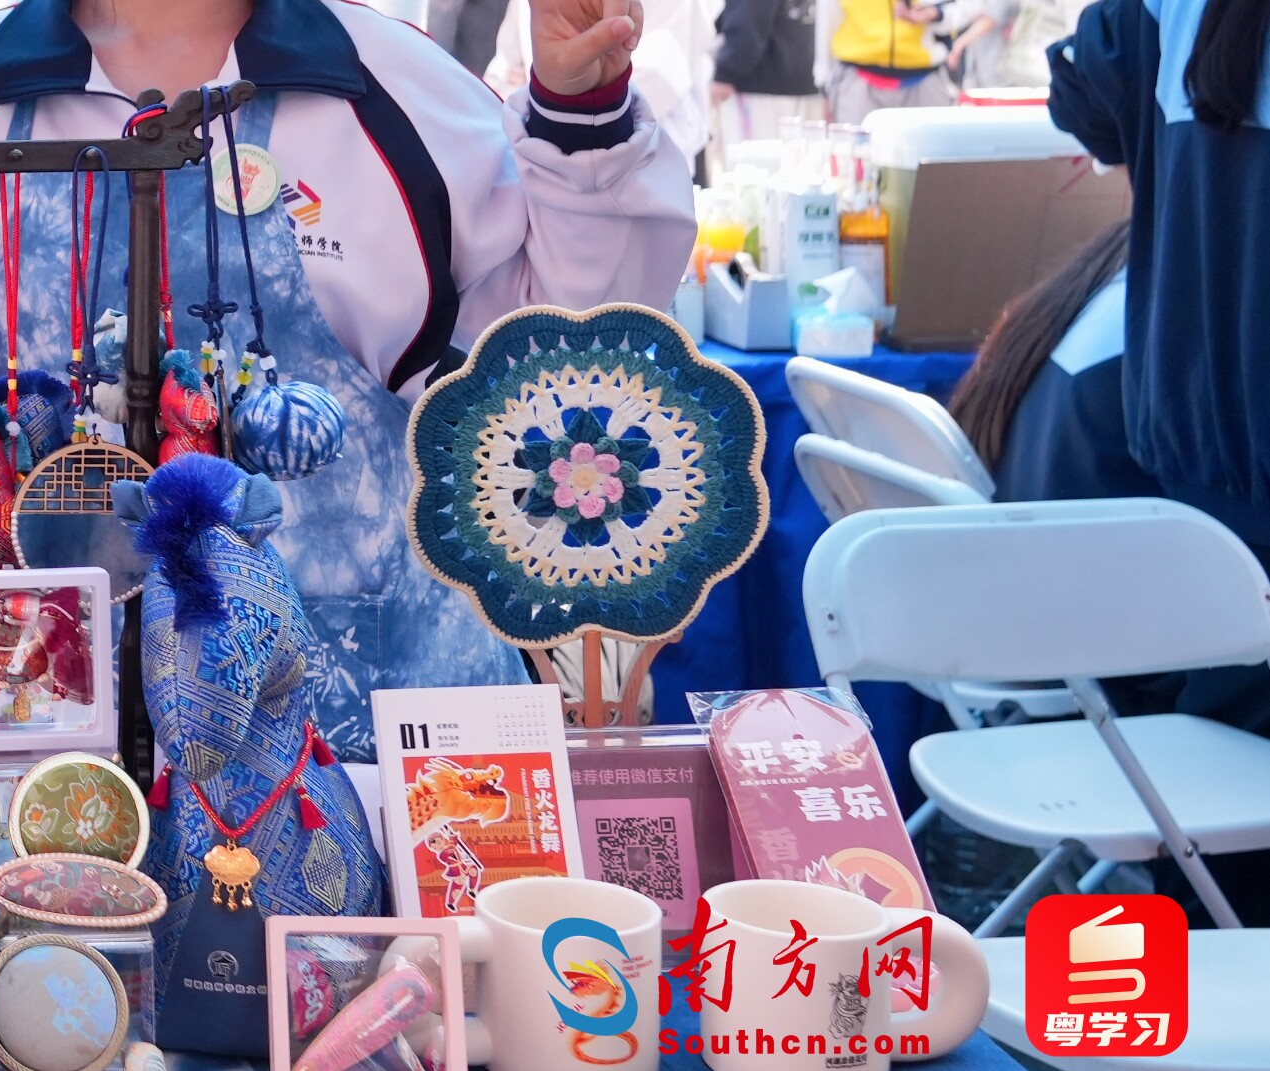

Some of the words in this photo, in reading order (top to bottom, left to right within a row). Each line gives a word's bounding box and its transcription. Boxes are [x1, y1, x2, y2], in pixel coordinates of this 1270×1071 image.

[292, 234, 343, 254] 师学院
[399, 723, 430, 749] 01
[735, 738, 828, 774] 平安
[531, 768, 561, 854] 香火龙舞
[794, 784, 888, 822] 喜乐
